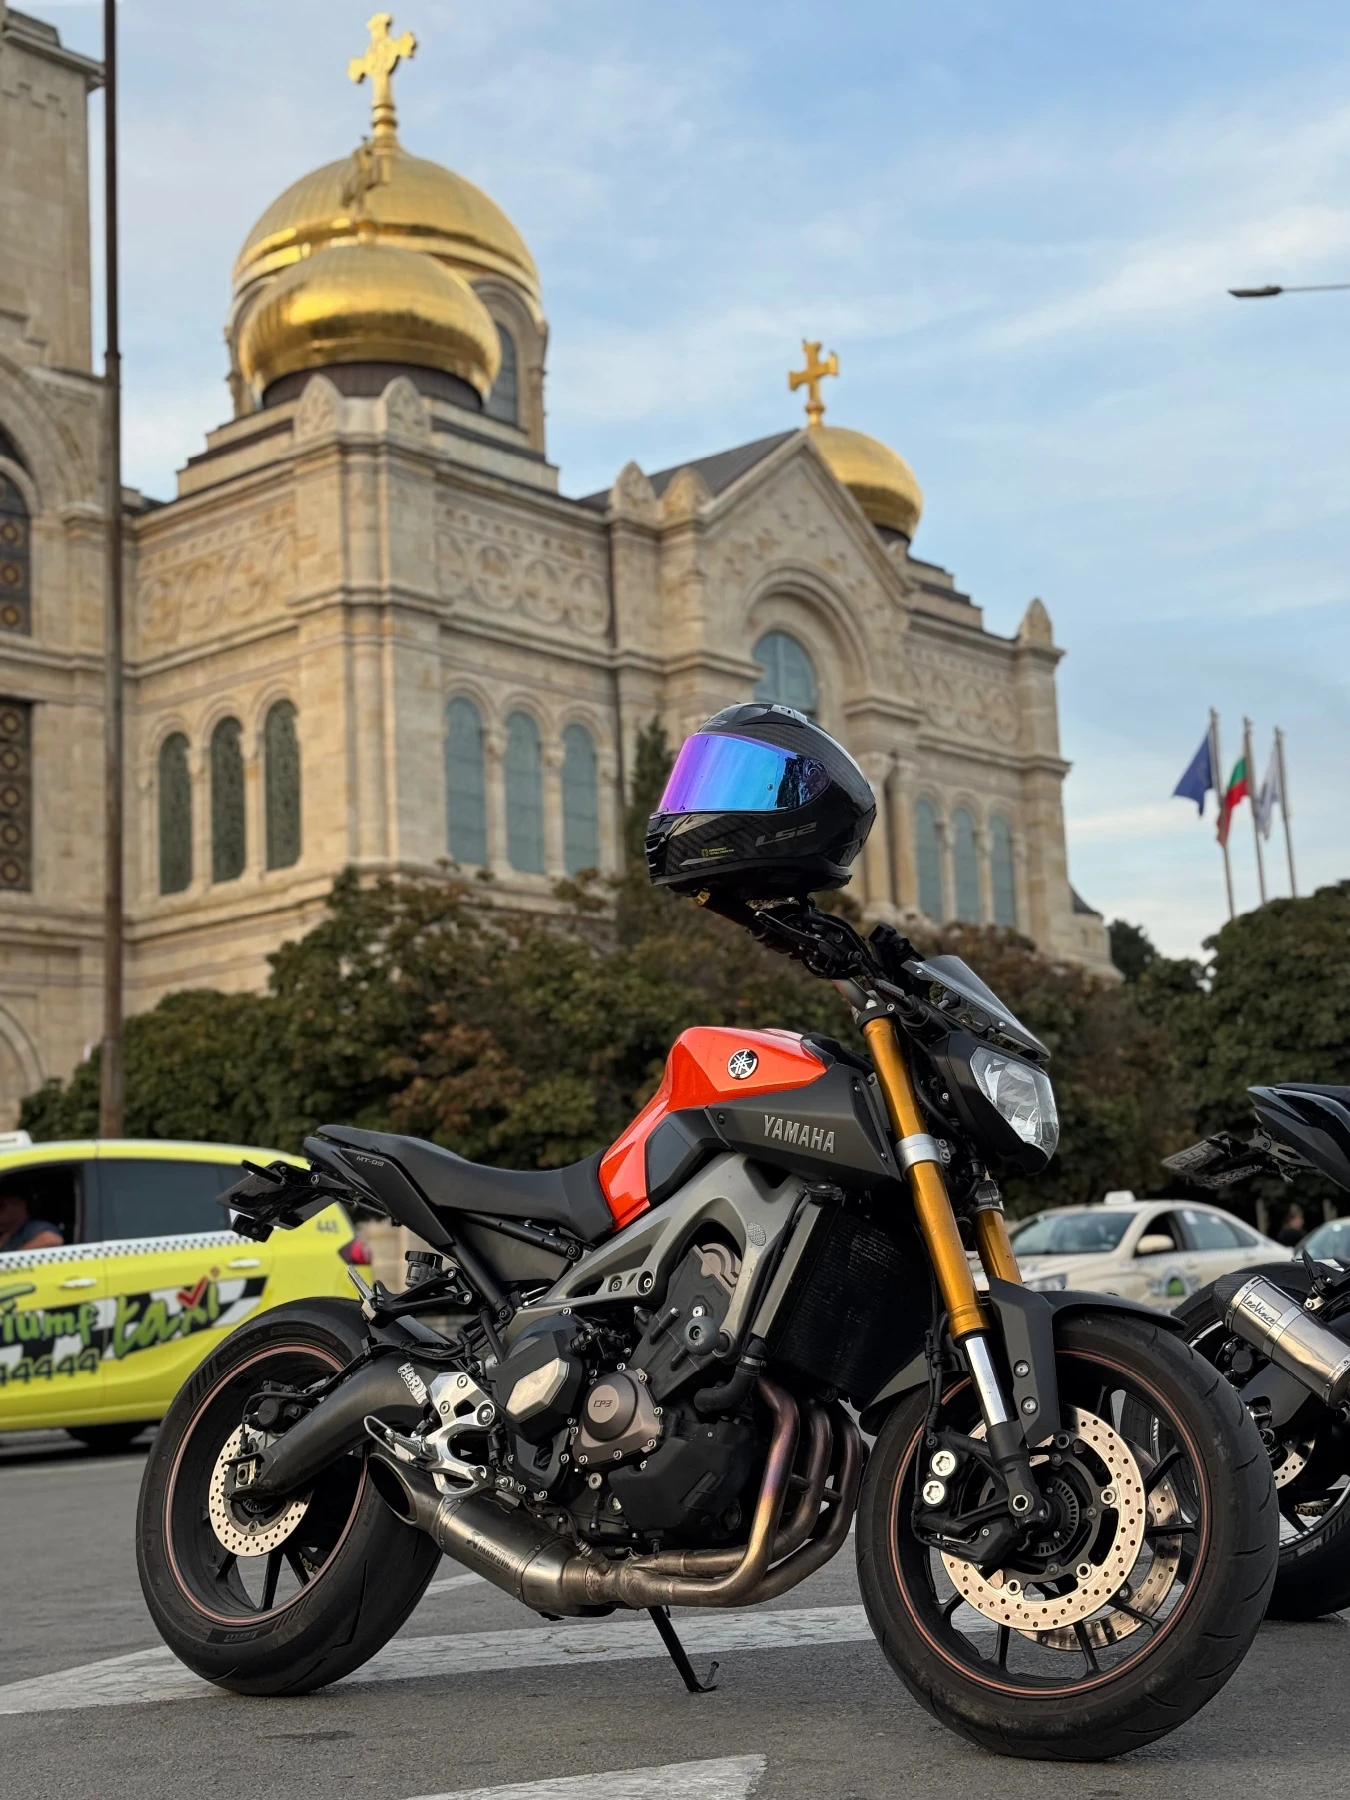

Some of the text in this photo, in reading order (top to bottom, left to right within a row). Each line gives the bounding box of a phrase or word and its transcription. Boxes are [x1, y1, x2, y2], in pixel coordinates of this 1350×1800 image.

[755, 821, 817, 847] LS2
[763, 1114, 835, 1154] YAMAHA
[356, 1155, 385, 1167] MT-09
[593, 1399, 613, 1408] CP3
